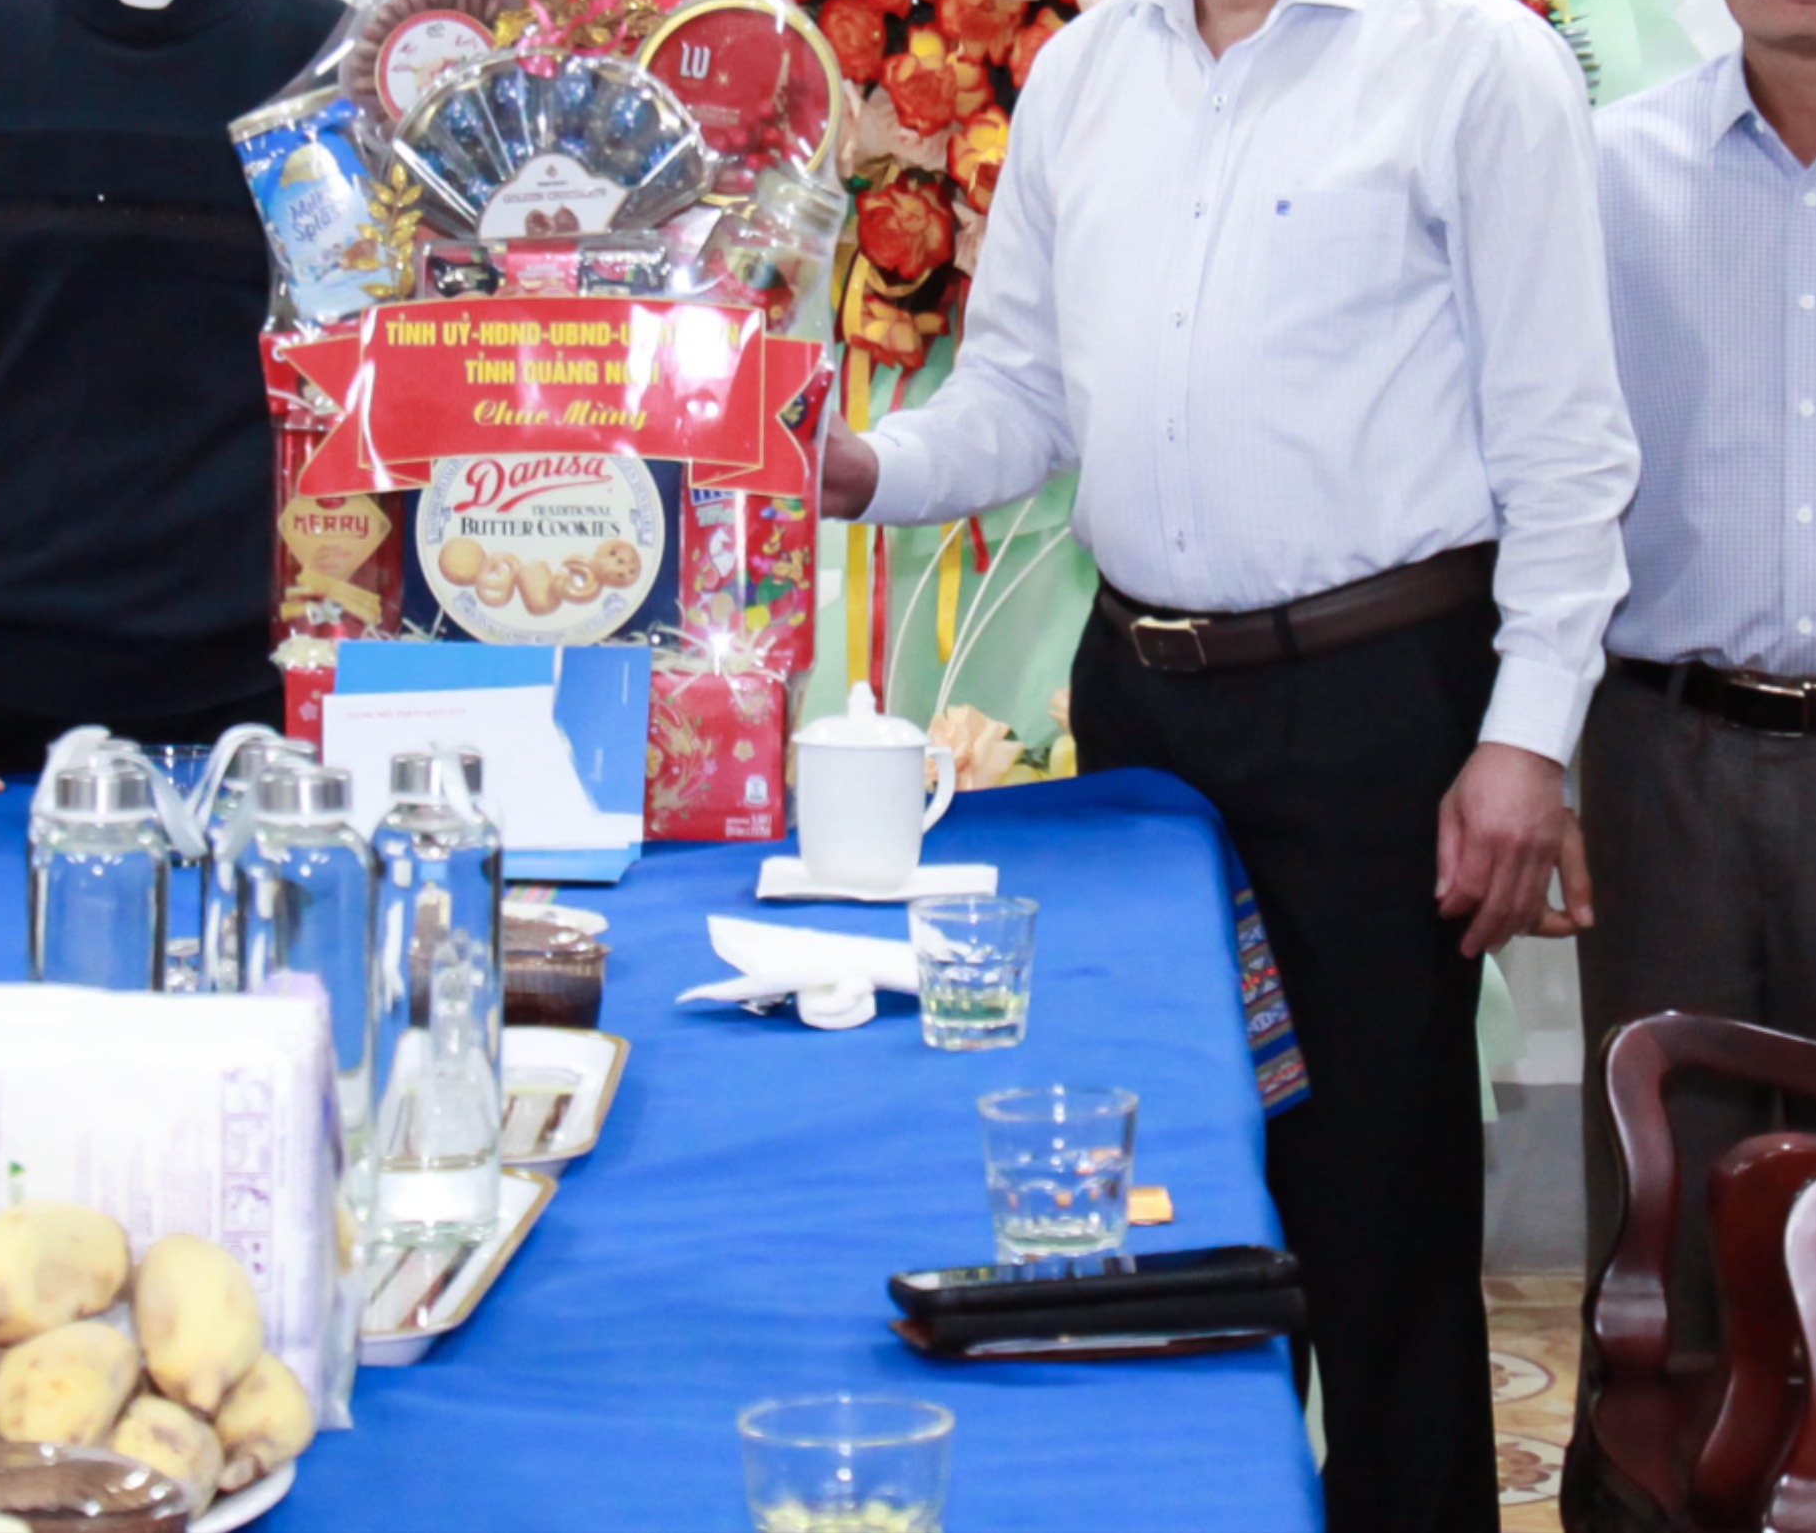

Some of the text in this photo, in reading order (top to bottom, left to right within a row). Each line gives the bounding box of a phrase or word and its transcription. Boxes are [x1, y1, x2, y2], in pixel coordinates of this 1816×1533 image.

[680, 38, 711, 79] LU
[385, 312, 437, 347] TỈNH
[464, 351, 515, 385] TỈNH
[453, 455, 607, 513] Danisa
